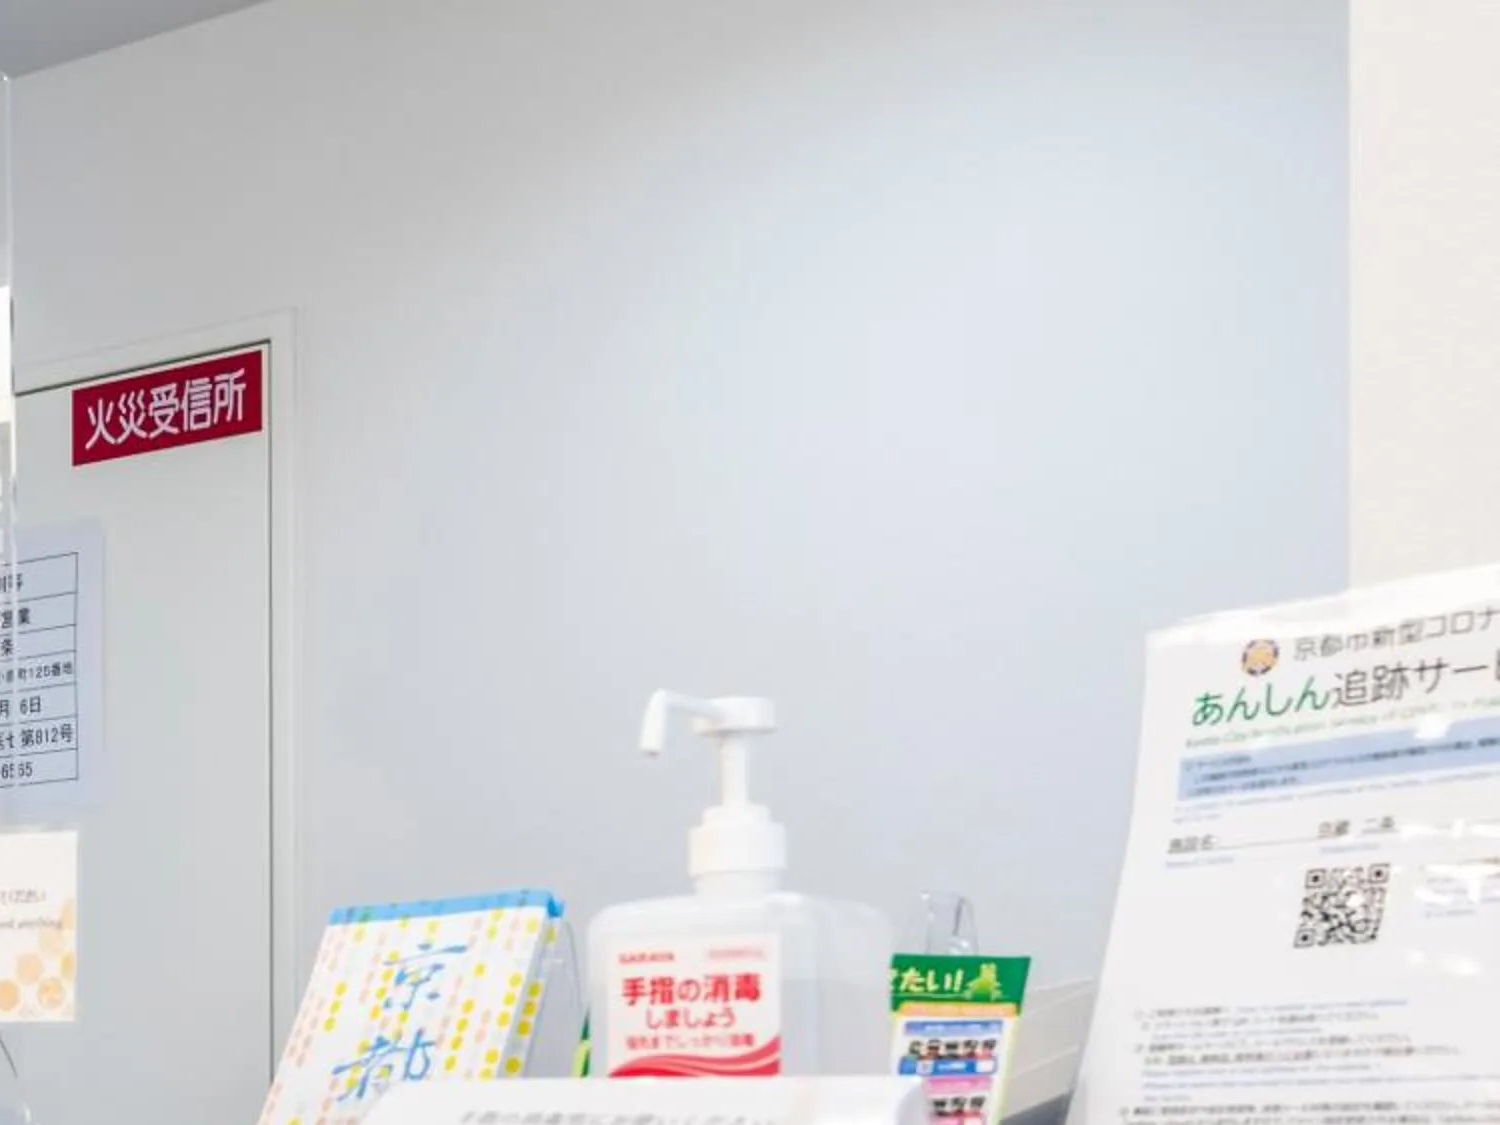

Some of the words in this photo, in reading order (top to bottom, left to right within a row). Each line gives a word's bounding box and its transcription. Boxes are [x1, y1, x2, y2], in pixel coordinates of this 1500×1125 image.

[85, 367, 247, 450] 火災受信所
[1191, 647, 1500, 727] あんしん追跡サー
[621, 972, 762, 1006] 手指の消毒
[645, 1006, 737, 1030] しましょう
